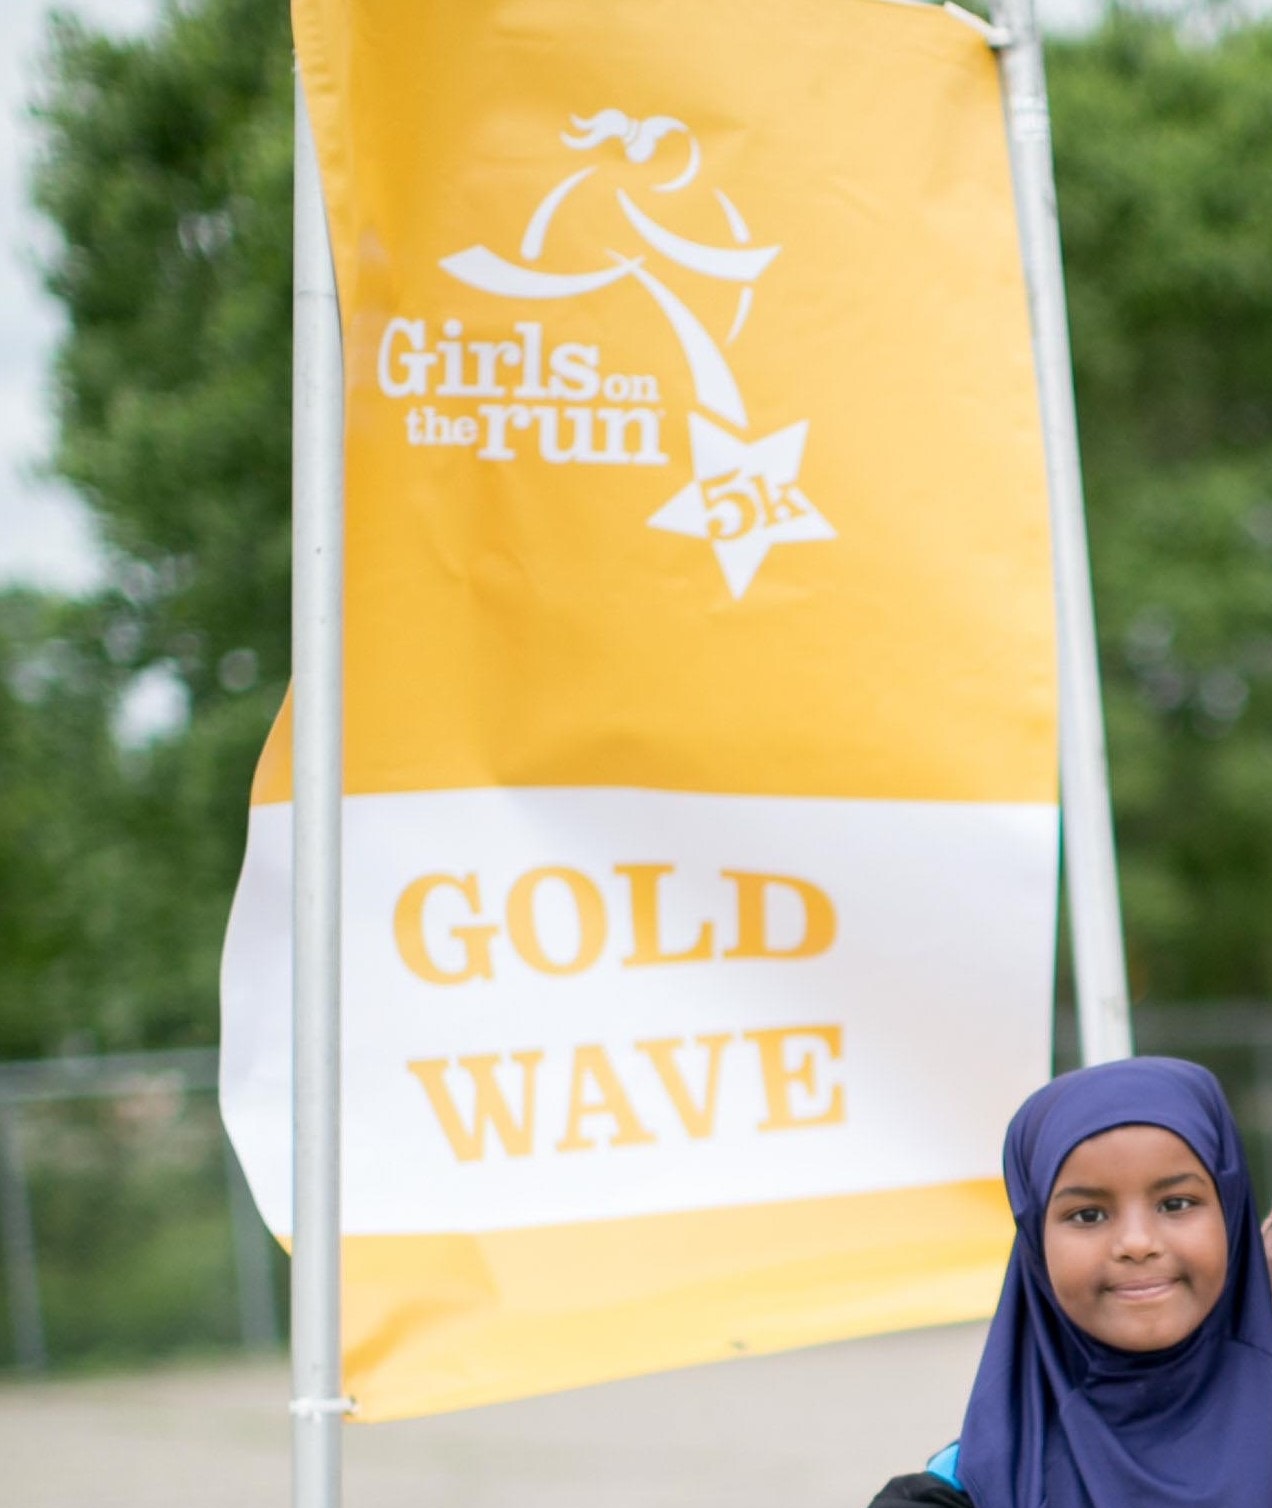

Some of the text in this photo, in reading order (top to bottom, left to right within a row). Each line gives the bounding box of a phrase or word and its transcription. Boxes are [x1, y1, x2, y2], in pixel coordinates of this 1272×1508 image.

[377, 317, 661, 401] Girls on
[405, 401, 668, 466] the run
[393, 861, 836, 986] GOLD
[406, 1023, 846, 1165] WAVE
